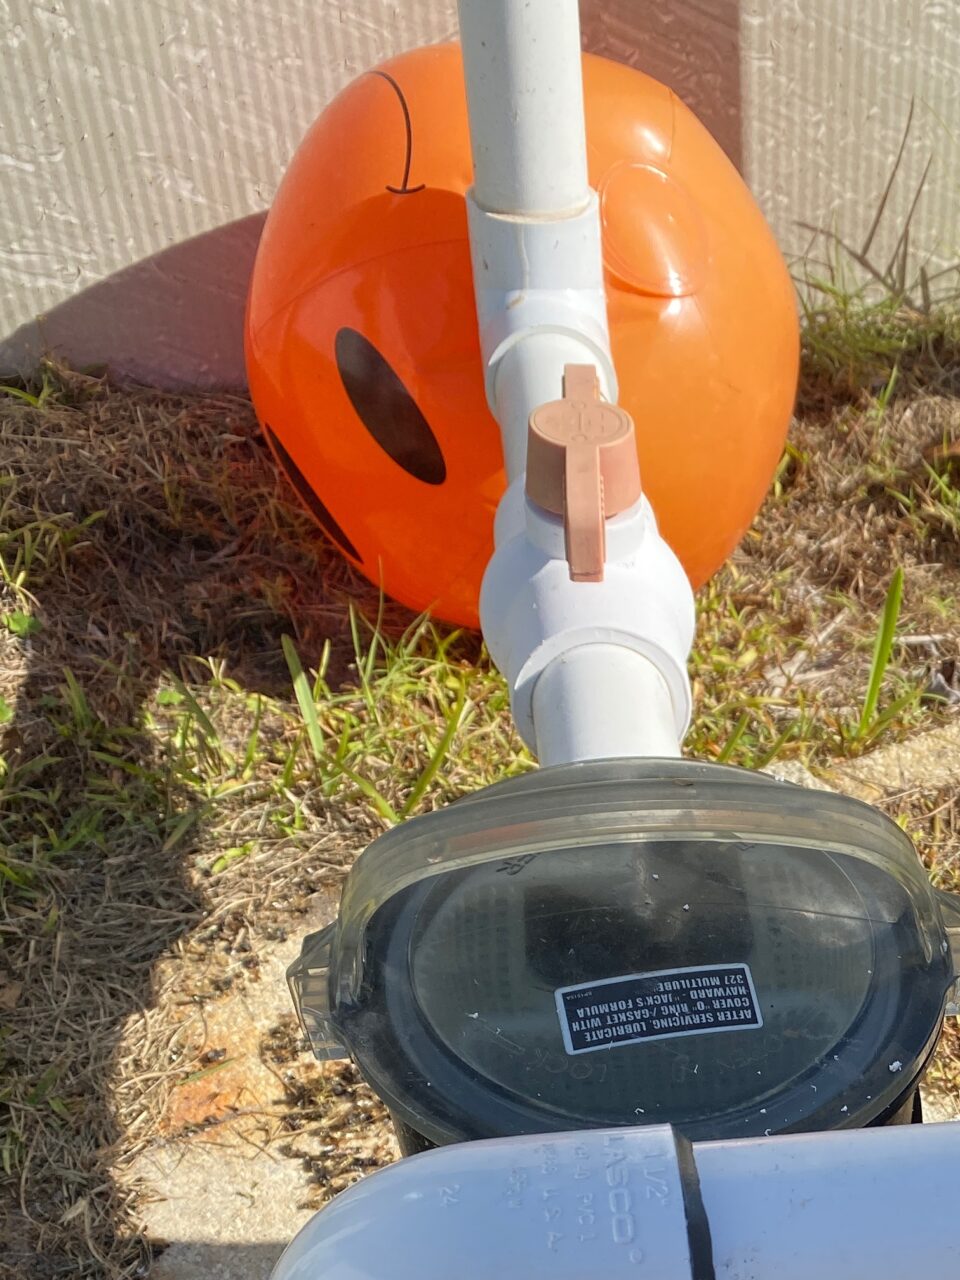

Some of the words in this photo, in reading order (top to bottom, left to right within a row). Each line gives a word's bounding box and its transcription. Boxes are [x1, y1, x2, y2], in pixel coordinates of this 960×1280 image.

[724, 974, 744, 985] 327
[690, 986, 748, 999] HAYWARD
[576, 1000, 633, 1018] FORMULA
[661, 1003, 689, 1015] RING
[714, 997, 750, 1009] COVER
[718, 1009, 752, 1021] AFTER
[571, 1016, 601, 1032] WITH
[585, 1021, 647, 1042] LUBRICATE
[603, 1135, 636, 1244] LASCO
